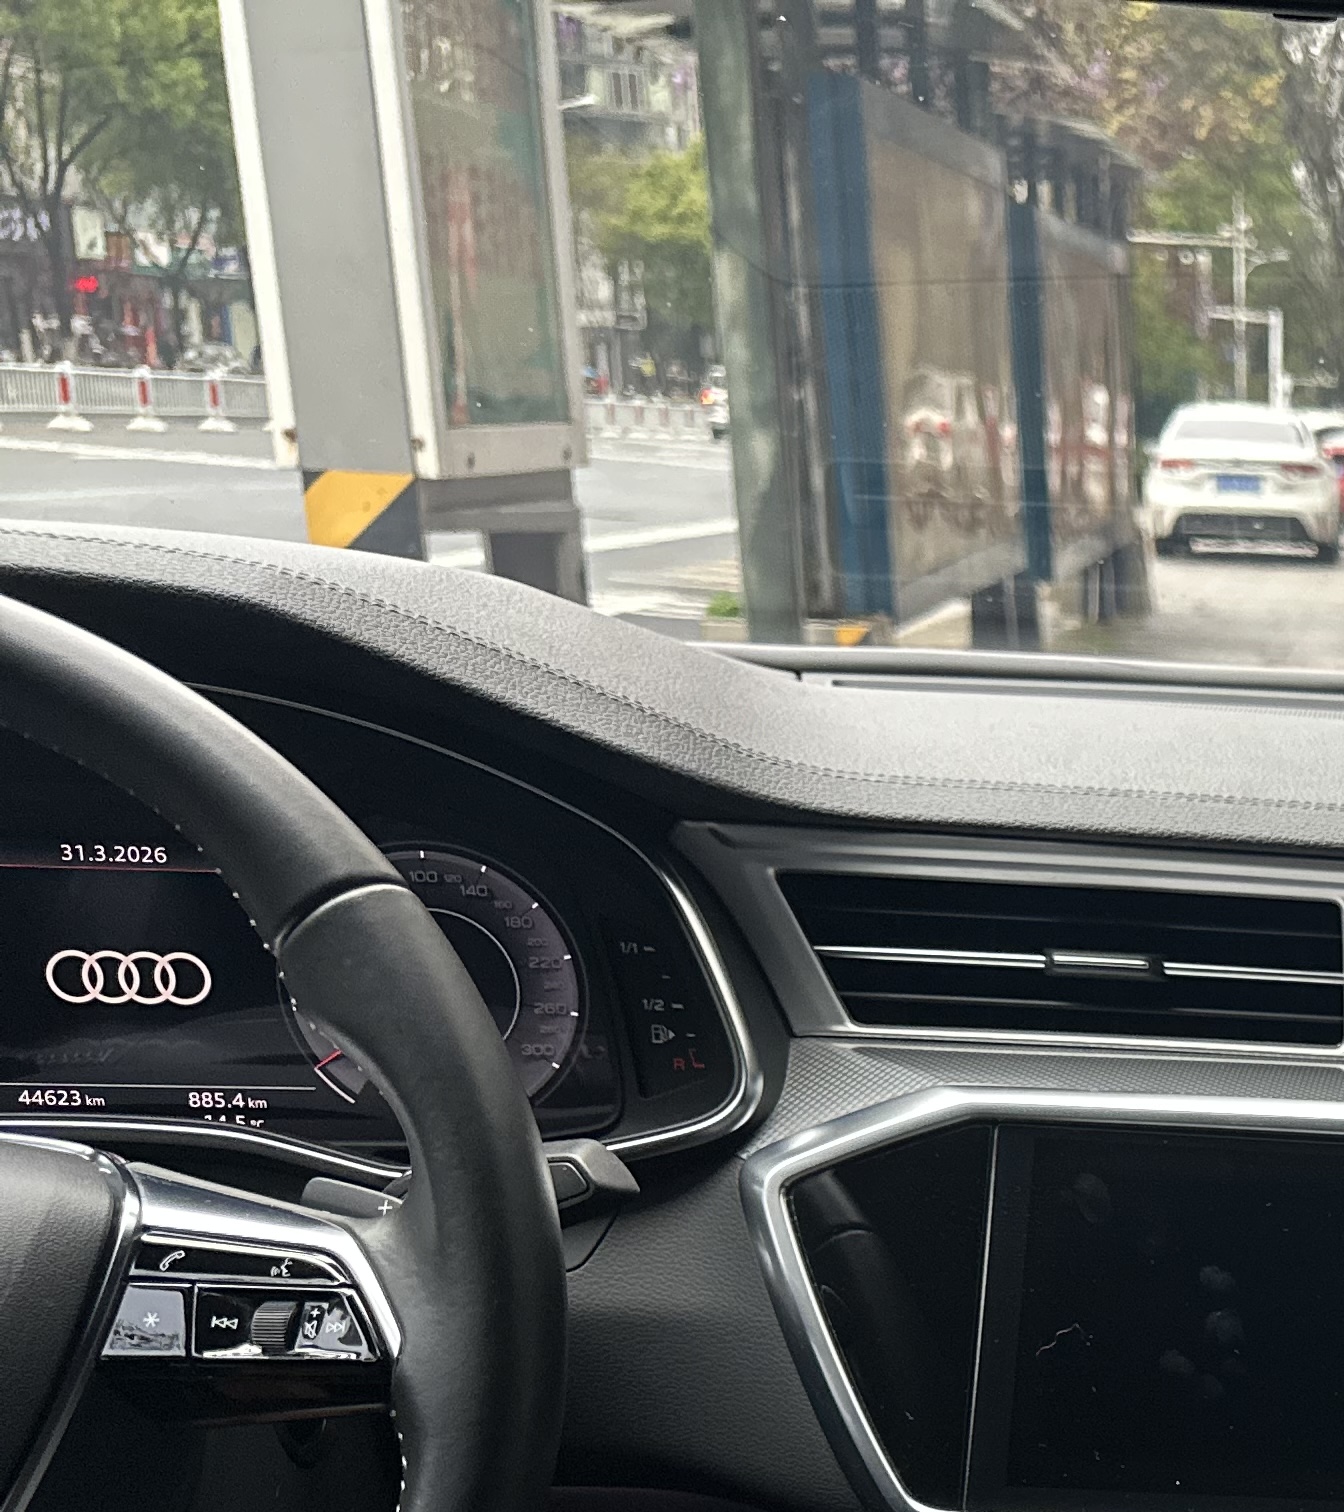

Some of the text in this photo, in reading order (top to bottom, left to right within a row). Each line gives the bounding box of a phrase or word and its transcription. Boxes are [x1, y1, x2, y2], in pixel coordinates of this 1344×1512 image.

[60, 844, 167, 863] 31.3.2026
[409, 871, 438, 883] 100
[459, 885, 488, 897] 140
[504, 916, 534, 929] 180
[528, 957, 563, 969] 220
[534, 1002, 567, 1015] 260
[642, 999, 665, 1011] 1/2
[521, 1043, 555, 1056] 300
[18, 1090, 105, 1106] 44623 km
[188, 1092, 268, 1109] 885.4 km
